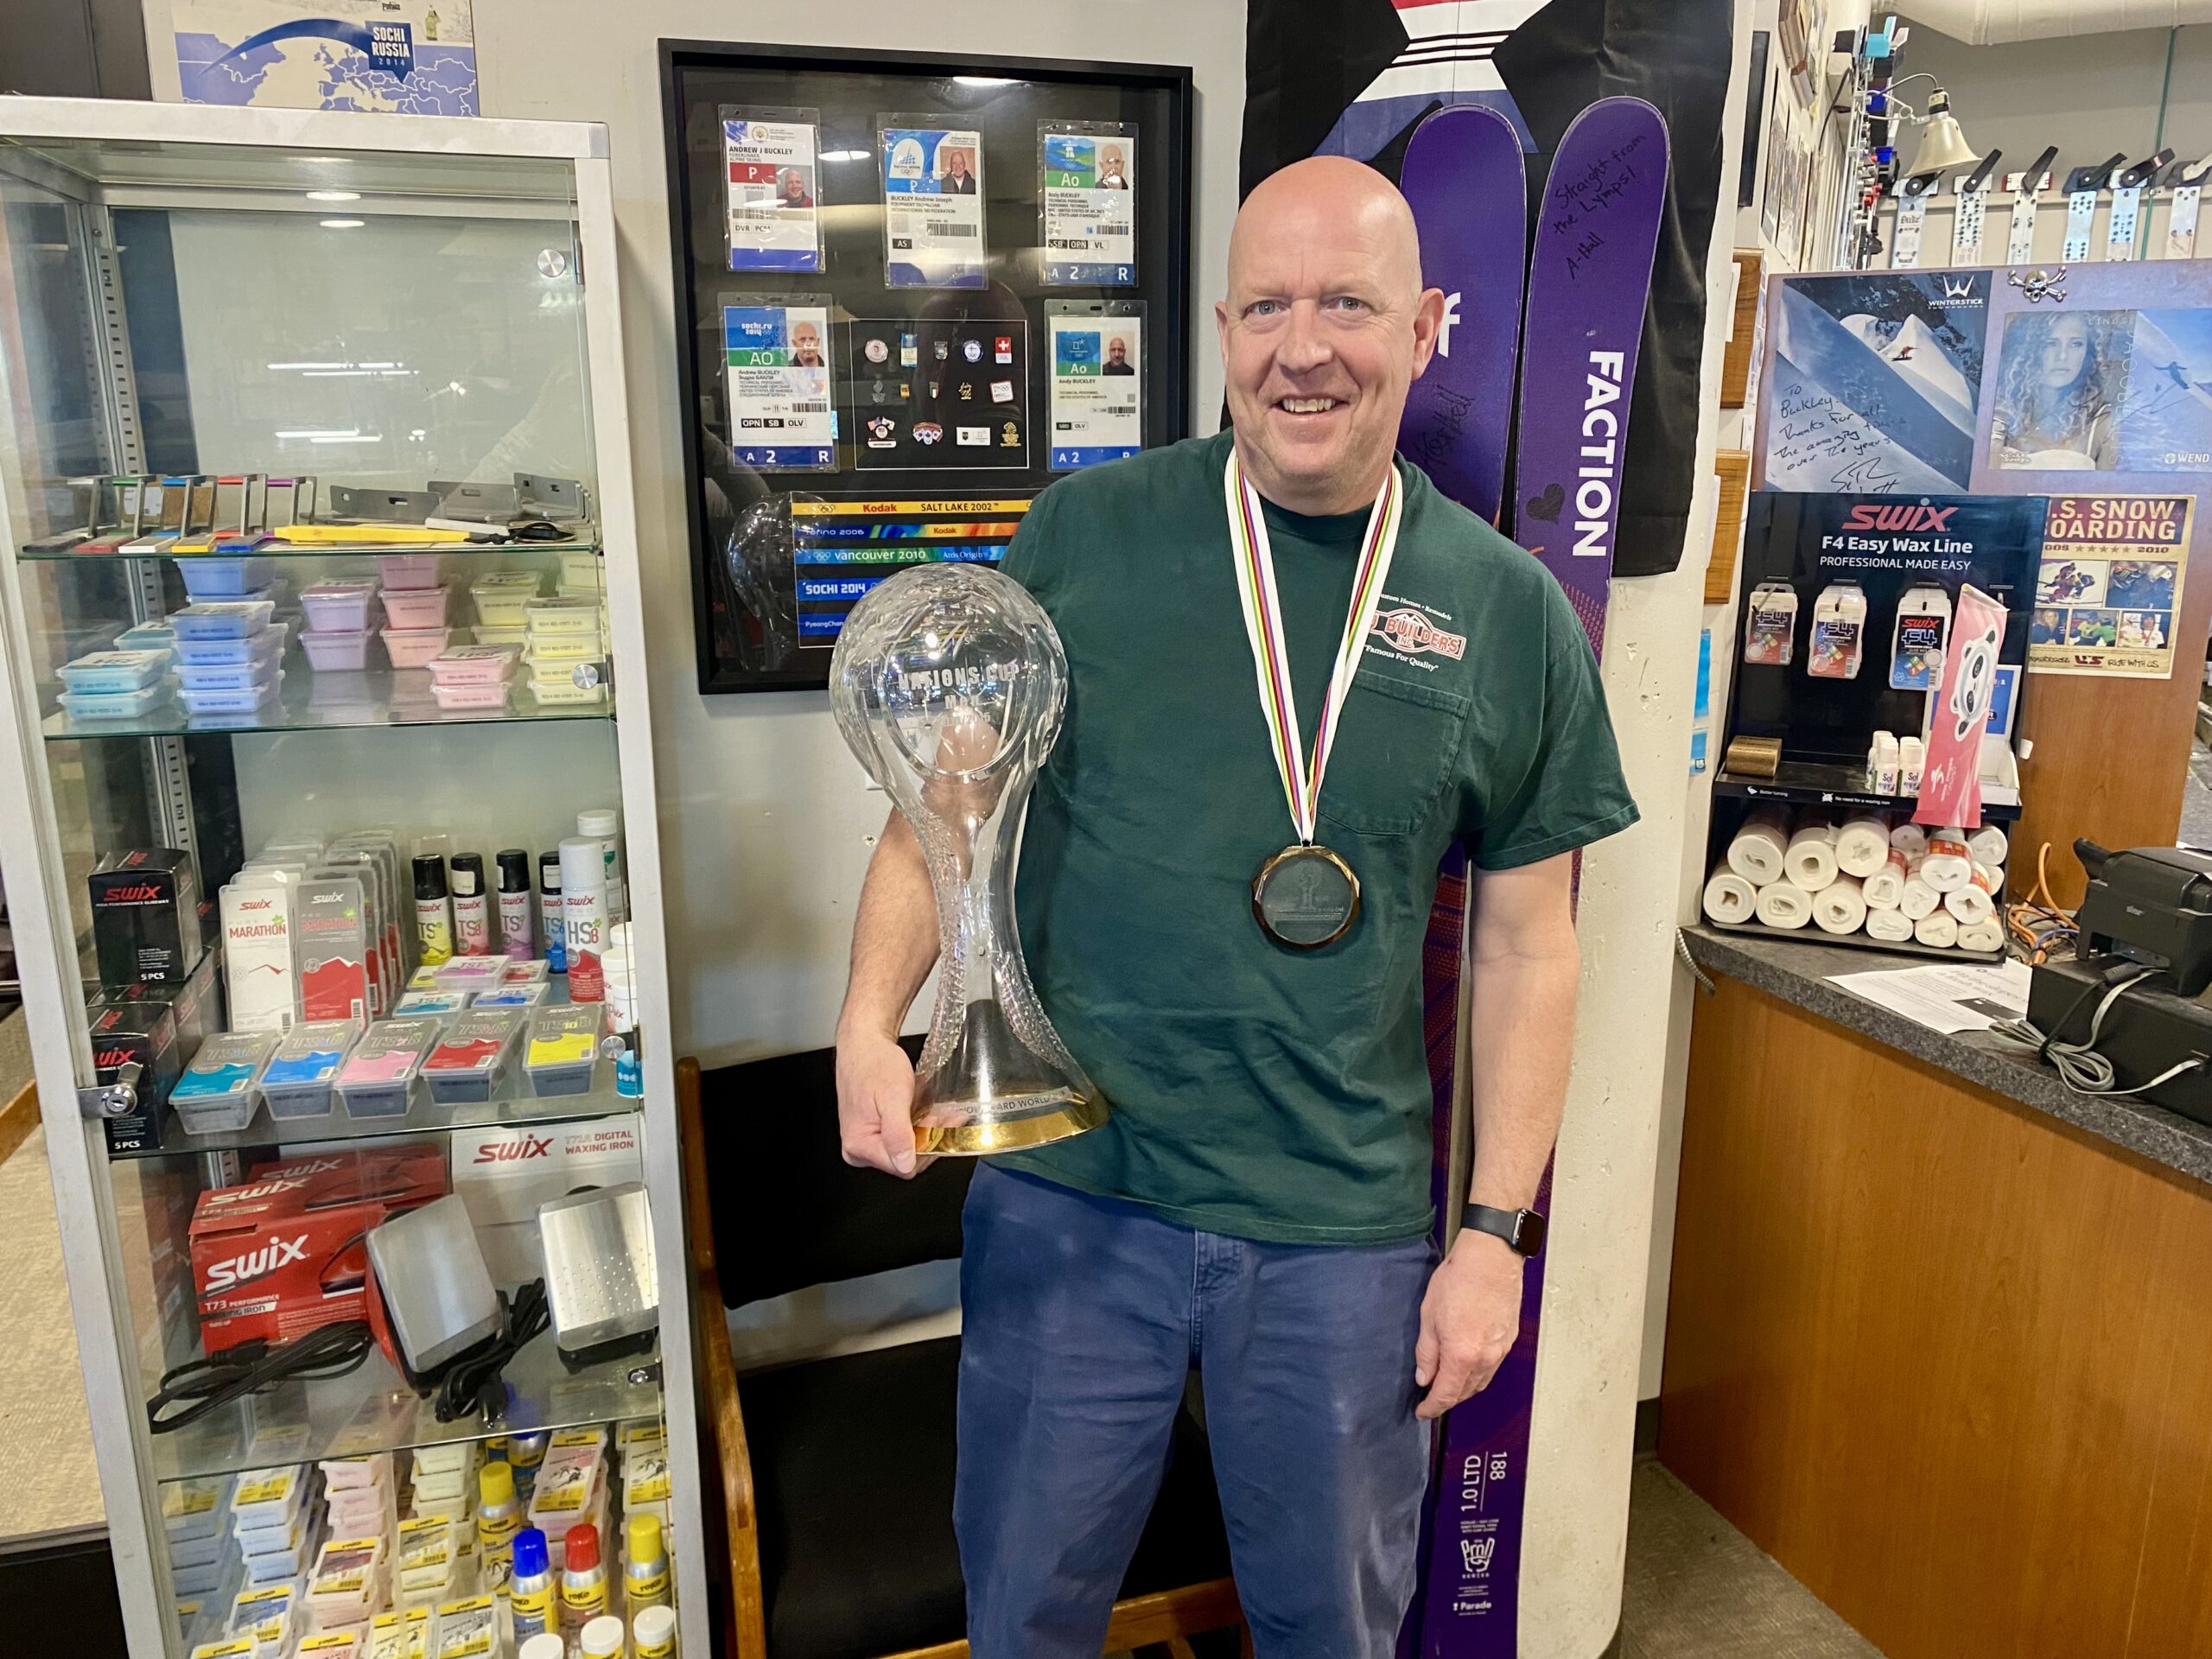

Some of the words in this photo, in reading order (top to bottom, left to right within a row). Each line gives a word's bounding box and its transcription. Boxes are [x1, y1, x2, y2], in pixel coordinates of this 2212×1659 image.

[373, 27, 405, 42] SOCHI
[372, 41, 410, 58] RUSSIA
[748, 167, 758, 180] P
[1555, 159, 1609, 210] Straight
[1611, 134, 1646, 162] from
[1554, 215, 1579, 235] the
[1052, 268, 1058, 277] A
[1070, 266, 1078, 279] 2
[1118, 267, 1128, 280] R
[1928, 298, 1984, 307] WINTERSTICK
[746, 452, 754, 461] A
[766, 450, 776, 463] 2
[818, 450, 829, 463] R
[1058, 453, 1067, 463] A
[1071, 452, 1079, 463] 2
[1573, 351, 1624, 556] FACTION
[1787, 454, 1817, 471] over
[1853, 436, 1891, 455] years
[2177, 454, 2210, 464] WEND
[863, 504, 897, 512] Kodak
[946, 503, 969, 512] LAKE
[2089, 500, 2176, 520] SNOW
[2045, 518, 2176, 540] OARDING
[1821, 536, 1844, 550] F4
[1848, 537, 1890, 555] Easy
[1892, 538, 1930, 553] Wax
[1933, 539, 1974, 554] Line
[835, 551, 894, 561] vancouver
[899, 550, 926, 560] 2010
[959, 550, 983, 560] Origin
[1820, 556, 1904, 569] PROFESSIONAL
[1905, 560, 1939, 570] MADE
[1941, 561, 1972, 571] EASY
[805, 585, 838, 594] SOCHI
[841, 583, 866, 594] 2014
[1400, 598, 1421, 608] Homes
[1424, 605, 1452, 621] Remodels
[1385, 617, 1460, 654] BUILDERS
[1901, 628, 1937, 646] F4
[1395, 652, 1409, 662] For
[899, 666, 980, 690] NATIONS
[985, 664, 1020, 683] CUP
[1882, 772, 1894, 784] Sol
[229, 925, 287, 938] MARATHON
[568, 920, 600, 944] HS8
[1018, 1096, 1049, 1107] WORLD
[594, 1130, 632, 1141] DIGITAL
[565, 1144, 607, 1155] WAXING
[609, 1141, 634, 1150] IRON
[205, 1300, 227, 1312] T73
[228, 1294, 281, 1308] PERFORMANCE
[243, 1304, 266, 1316] IRON
[1490, 1452, 1508, 1480] 188
